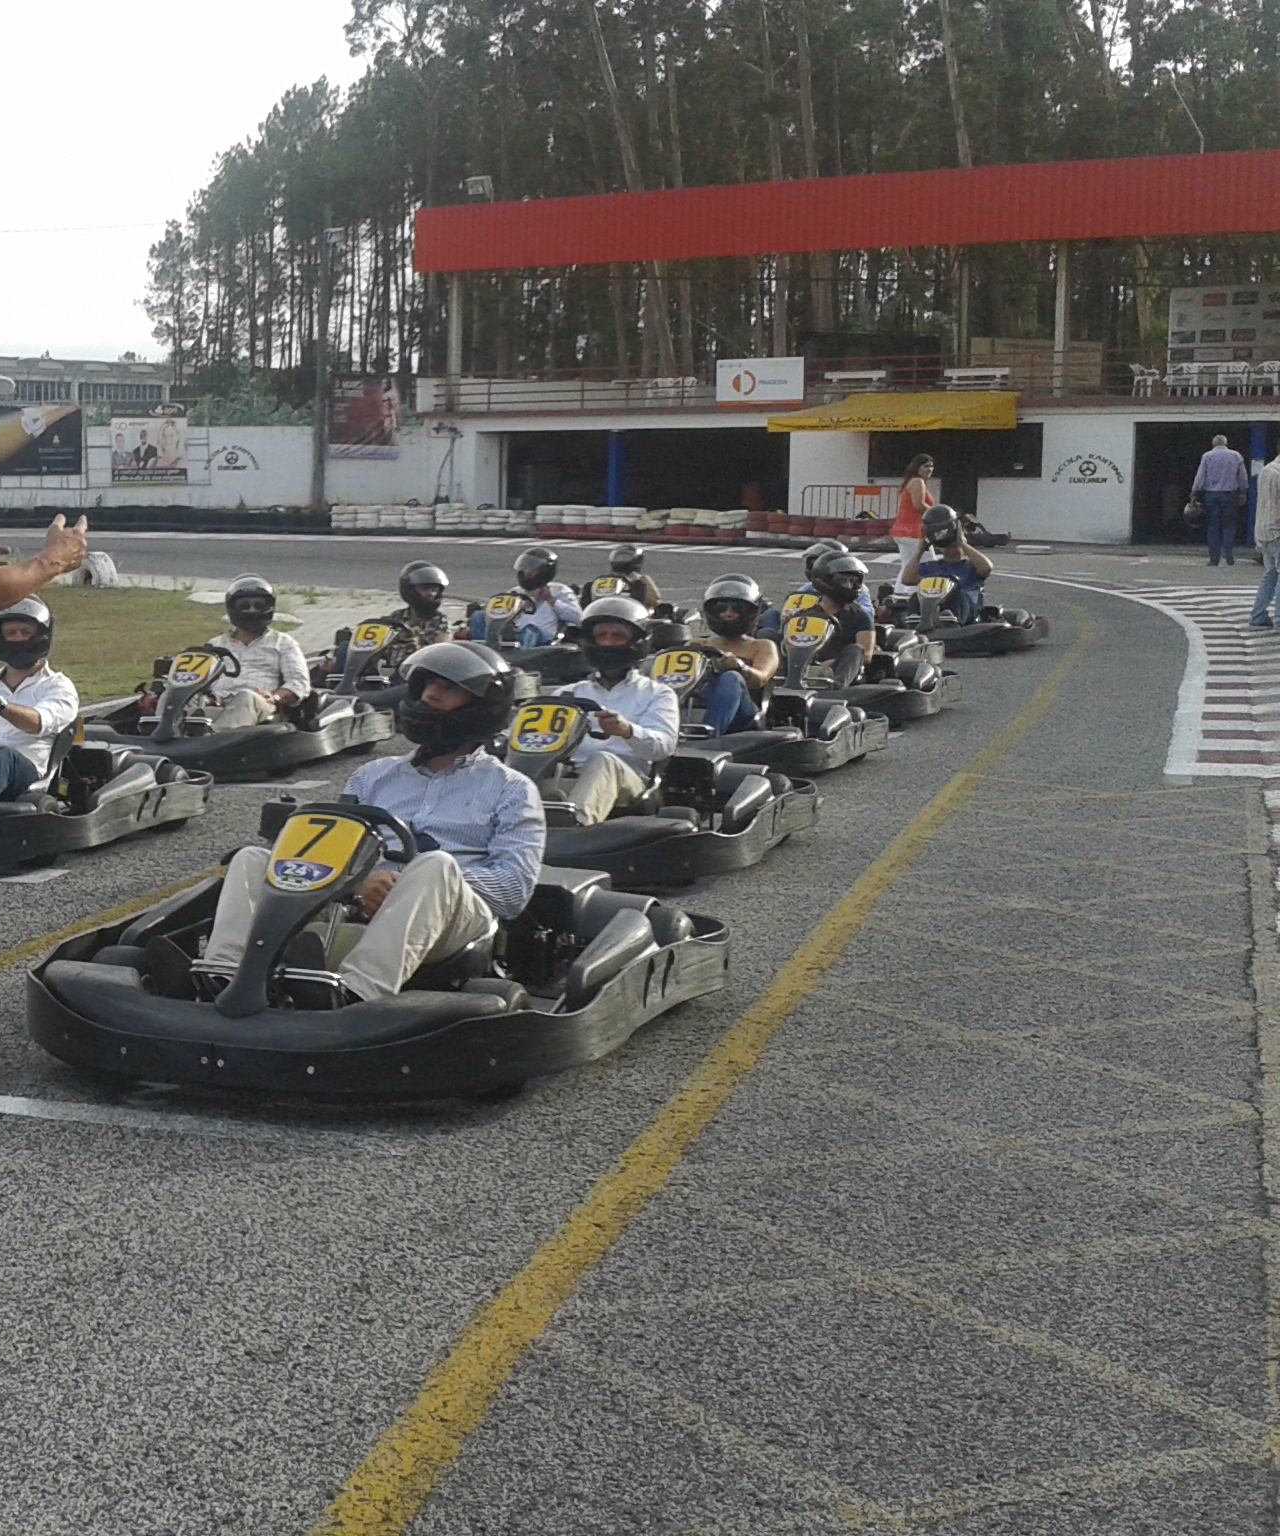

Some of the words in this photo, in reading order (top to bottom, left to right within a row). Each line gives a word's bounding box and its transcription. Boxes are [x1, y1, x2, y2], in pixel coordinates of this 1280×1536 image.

[792, 594, 805, 609] 4
[363, 625, 381, 641] 6
[795, 615, 808, 633] 9
[175, 653, 211, 673] 27
[663, 653, 695, 675] 19
[520, 707, 569, 734] 26
[293, 817, 338, 858] 7
